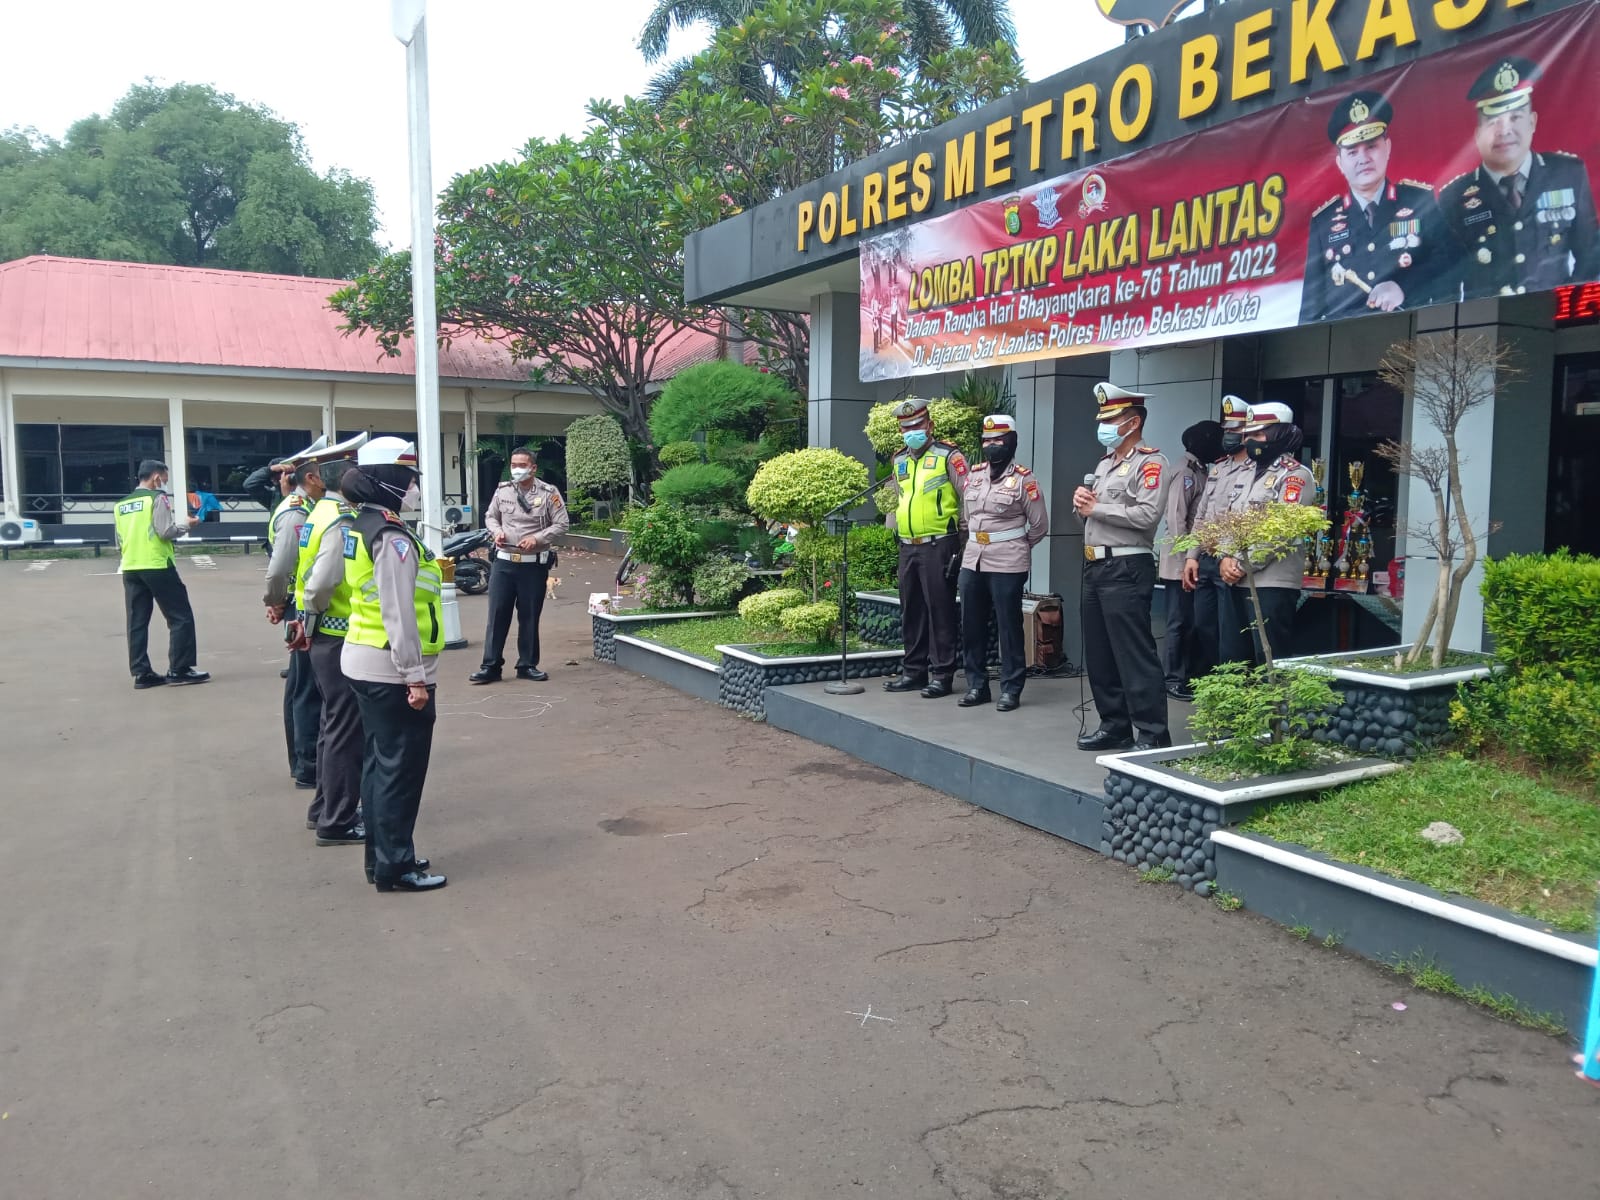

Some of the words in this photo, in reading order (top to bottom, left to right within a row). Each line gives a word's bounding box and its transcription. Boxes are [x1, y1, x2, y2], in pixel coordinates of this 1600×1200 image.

[797, 152, 932, 252] POLRES
[943, 63, 1153, 201] METRO
[1179, 0, 1529, 119] BEKA
[904, 314, 940, 341] Dalam
[943, 305, 986, 335] Rangka
[989, 297, 1014, 325] Hari
[1018, 283, 1110, 325] Bhayangkara
[1114, 267, 1162, 305] ke-76
[1168, 259, 1224, 294] Tahun
[1226, 242, 1278, 283] 2022
[907, 255, 977, 312] LOMBA
[981, 235, 1059, 297] TPTKP
[1062, 213, 1140, 280] LAKA
[1147, 173, 1286, 261] LANTAS
[912, 345, 924, 368] Di
[926, 341, 971, 370] Jajaran
[974, 335, 996, 360] Sat
[998, 329, 1044, 356] Lantas
[1047, 321, 1094, 350] Polres
[1097, 312, 1145, 343] Metro
[1147, 296, 1211, 336] Bekasi
[1213, 292, 1262, 327] Kota
[119, 501, 143, 515] POLISI
